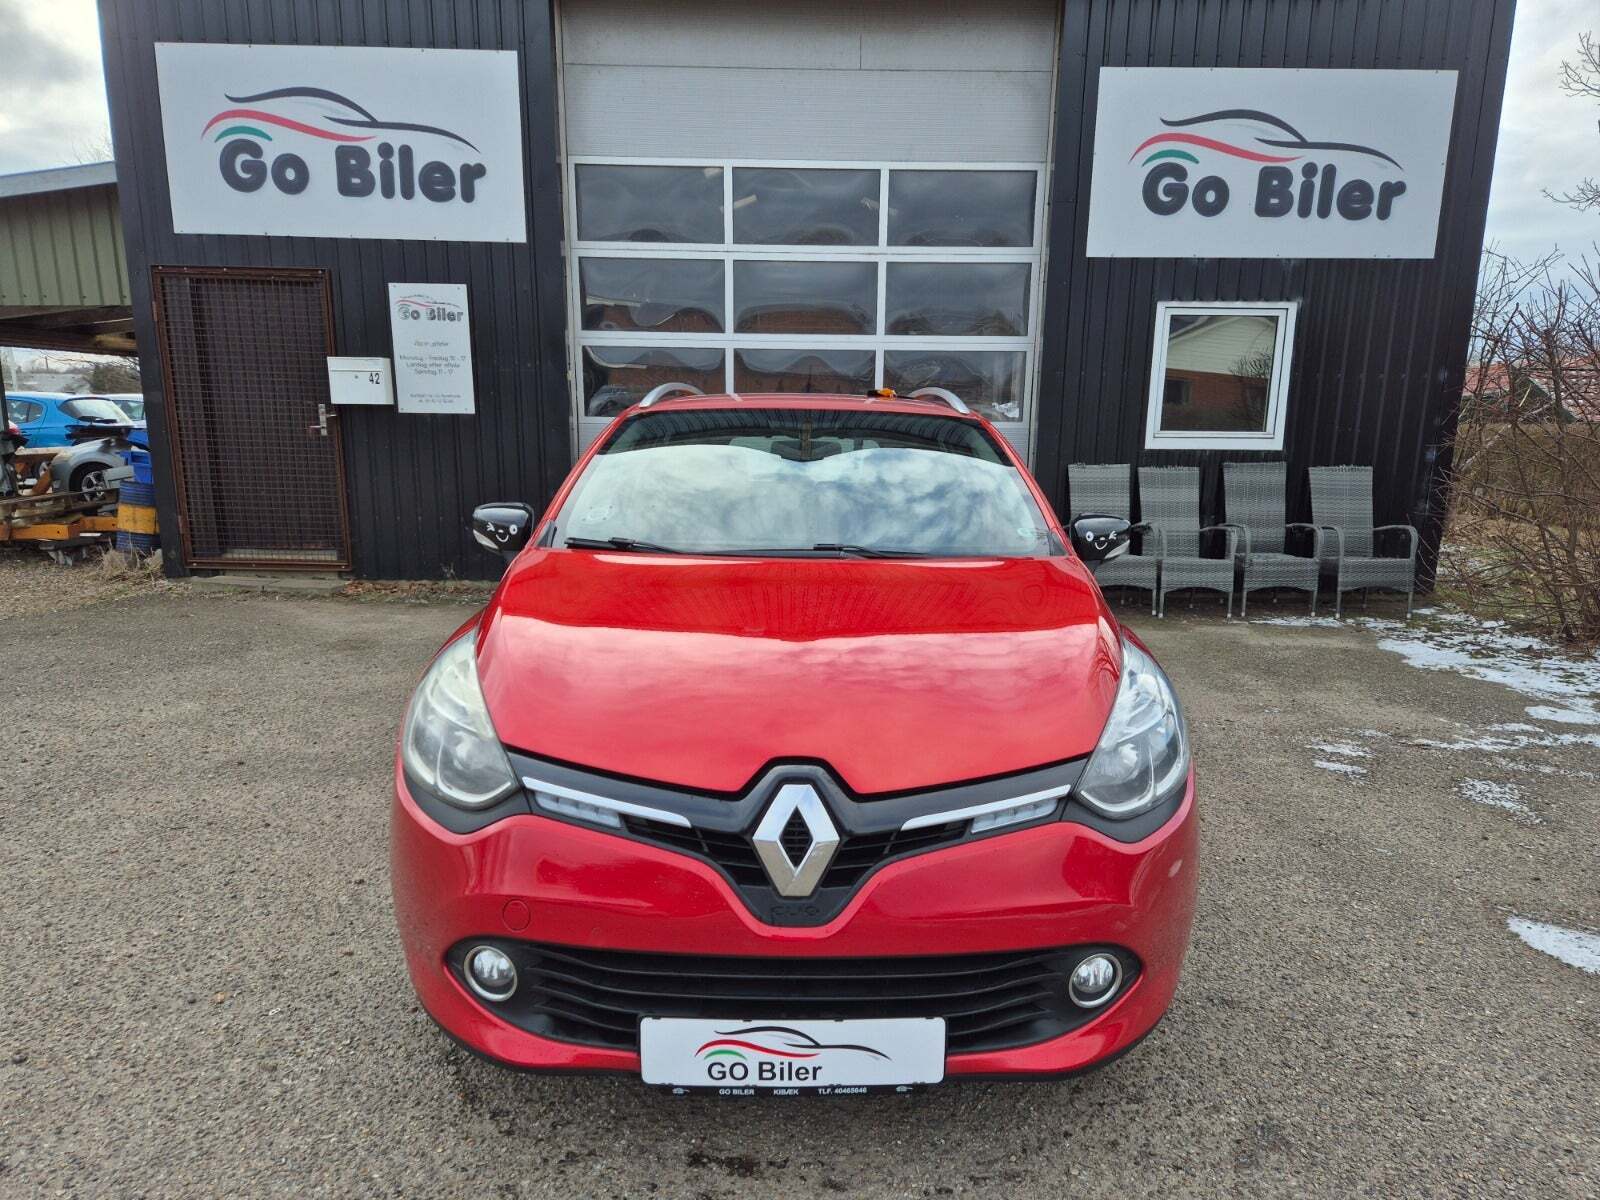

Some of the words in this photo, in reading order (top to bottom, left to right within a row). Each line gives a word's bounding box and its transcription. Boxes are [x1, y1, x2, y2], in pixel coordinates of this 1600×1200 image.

[219, 138, 309, 195] Go
[335, 142, 486, 203] Biler
[1142, 162, 1230, 217] Go
[1254, 161, 1407, 221] Biler
[424, 307, 463, 322] Biler
[368, 372, 381, 384] 42
[707, 1062, 749, 1081] GO
[758, 1061, 823, 1081] Biler
[719, 1088, 731, 1096] GO
[732, 1088, 755, 1096] BILER
